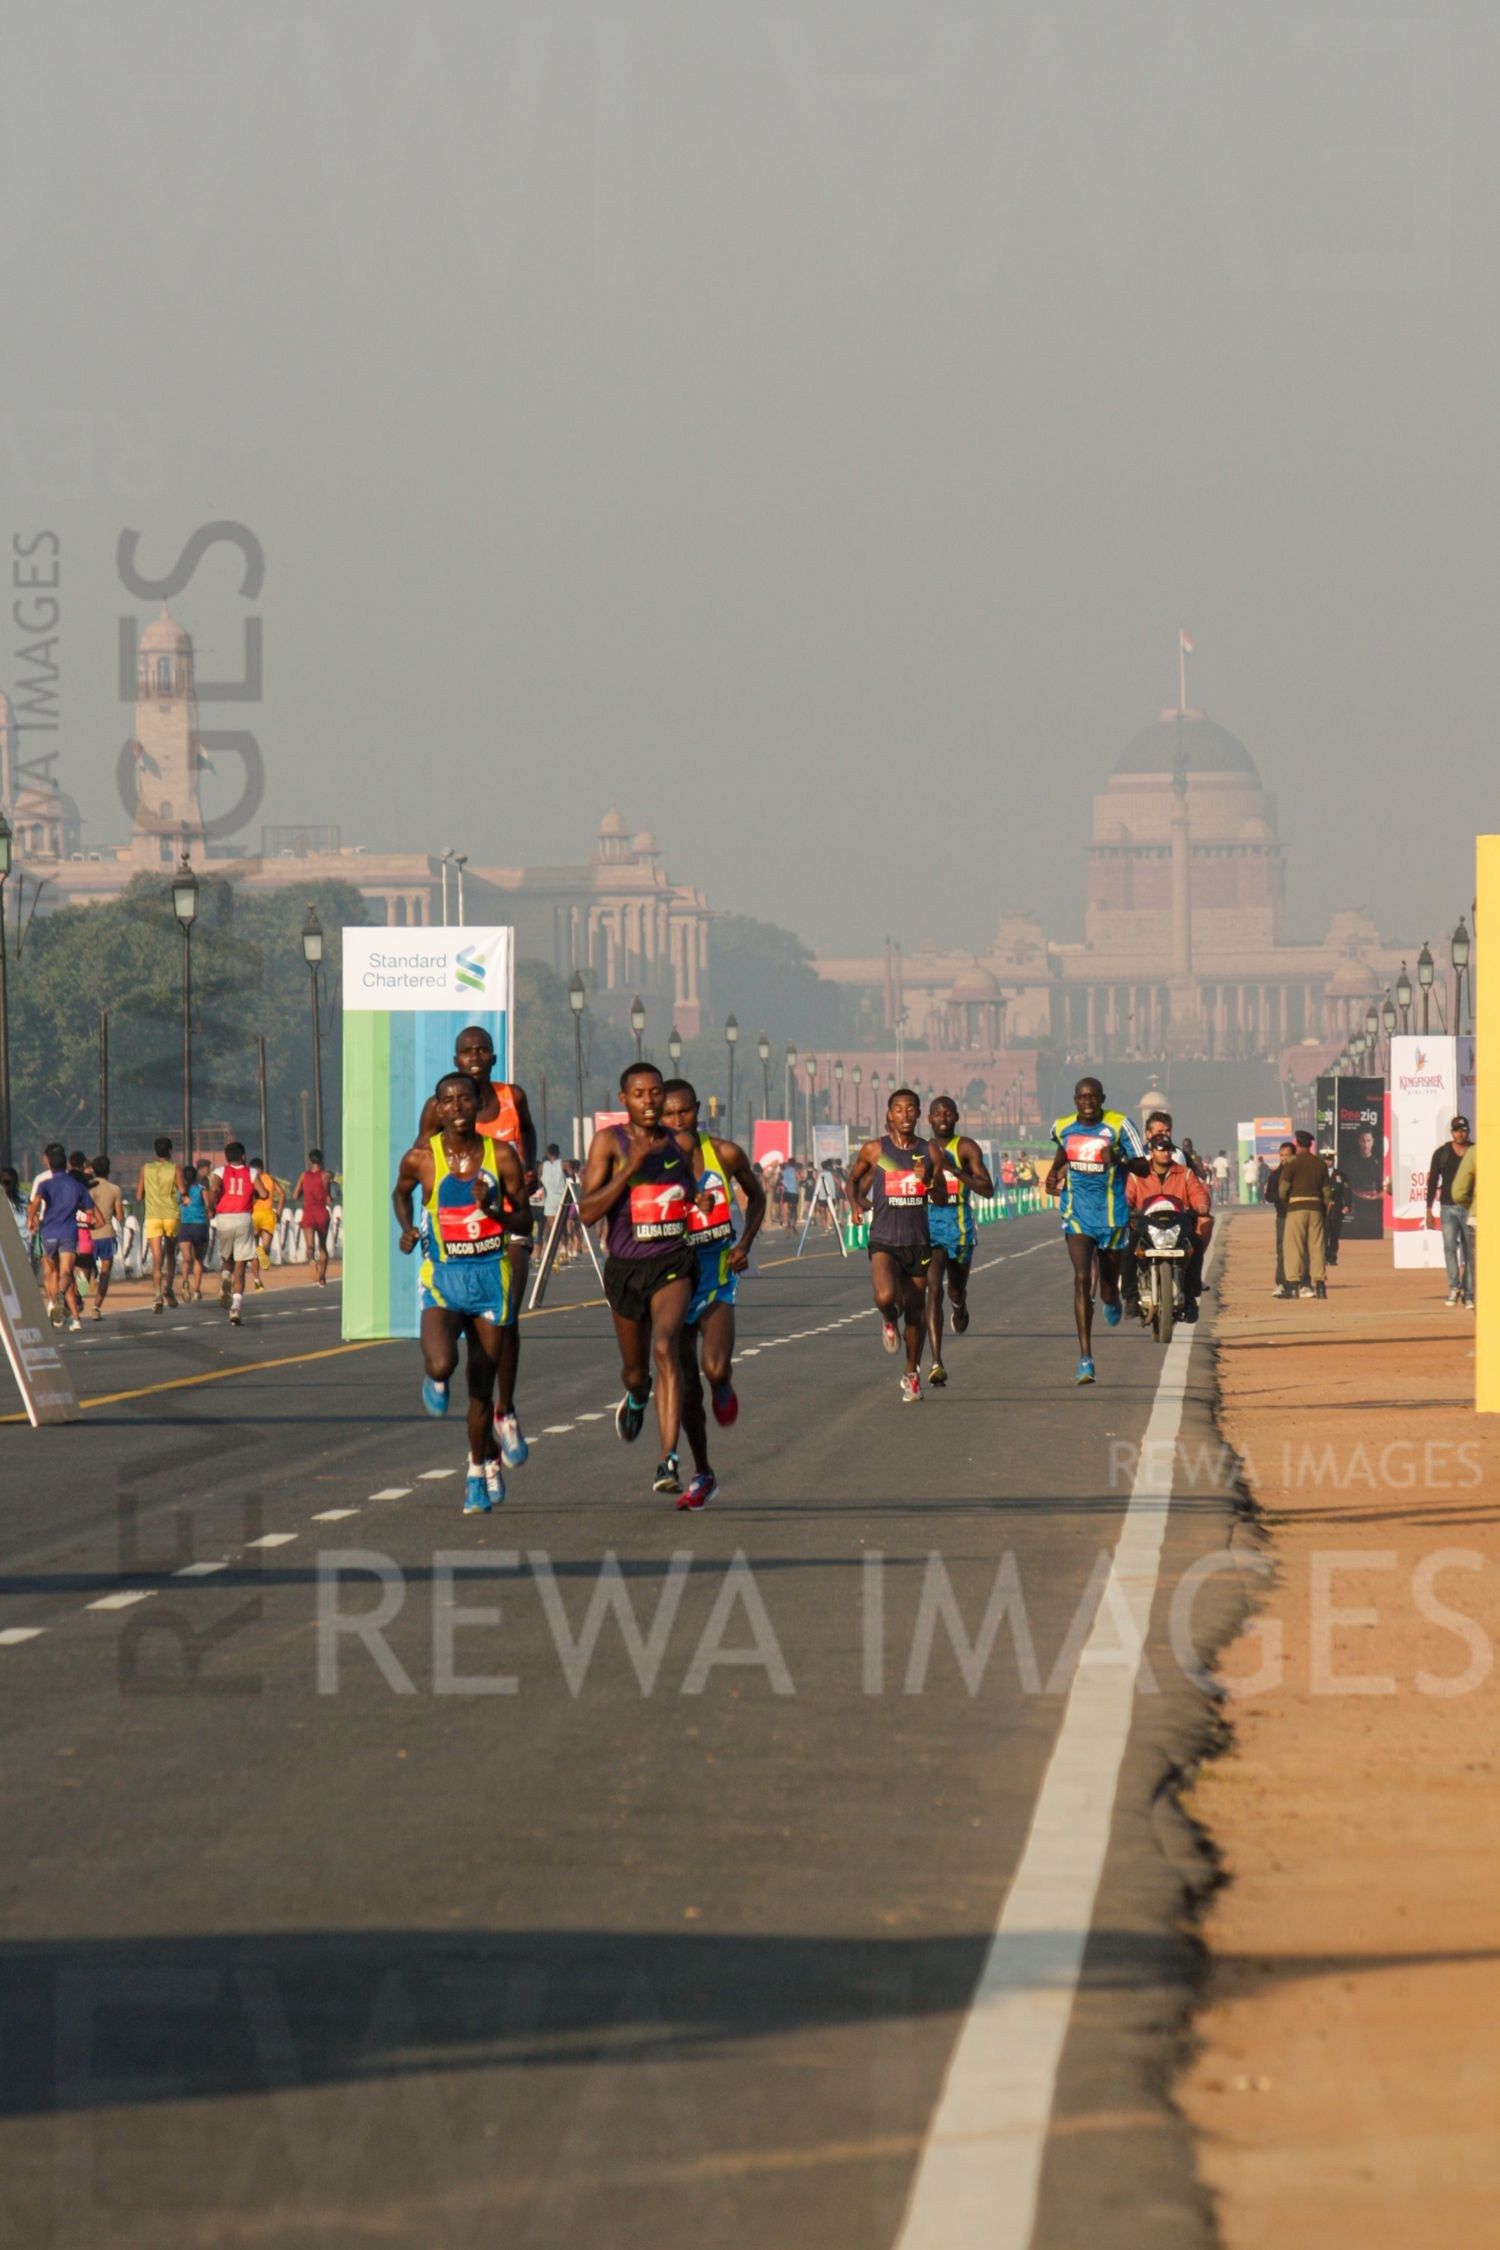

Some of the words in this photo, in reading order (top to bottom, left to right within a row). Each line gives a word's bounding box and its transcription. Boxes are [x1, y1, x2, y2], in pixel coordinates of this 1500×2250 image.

[369, 952, 446, 968] Standard
[362, 972, 446, 987] Chartered
[1399, 1074, 1445, 1091] KINGFISHER
[1079, 1148, 1095, 1161] 22
[229, 1178, 243, 1196] 11
[899, 1182, 916, 1195] 15
[658, 1202, 670, 1220] 7
[467, 1221, 480, 1239] 9
[636, 1224, 662, 1237] LELISA
[446, 1241, 475, 1255] YACOB
[475, 1237, 501, 1252] YARSO
